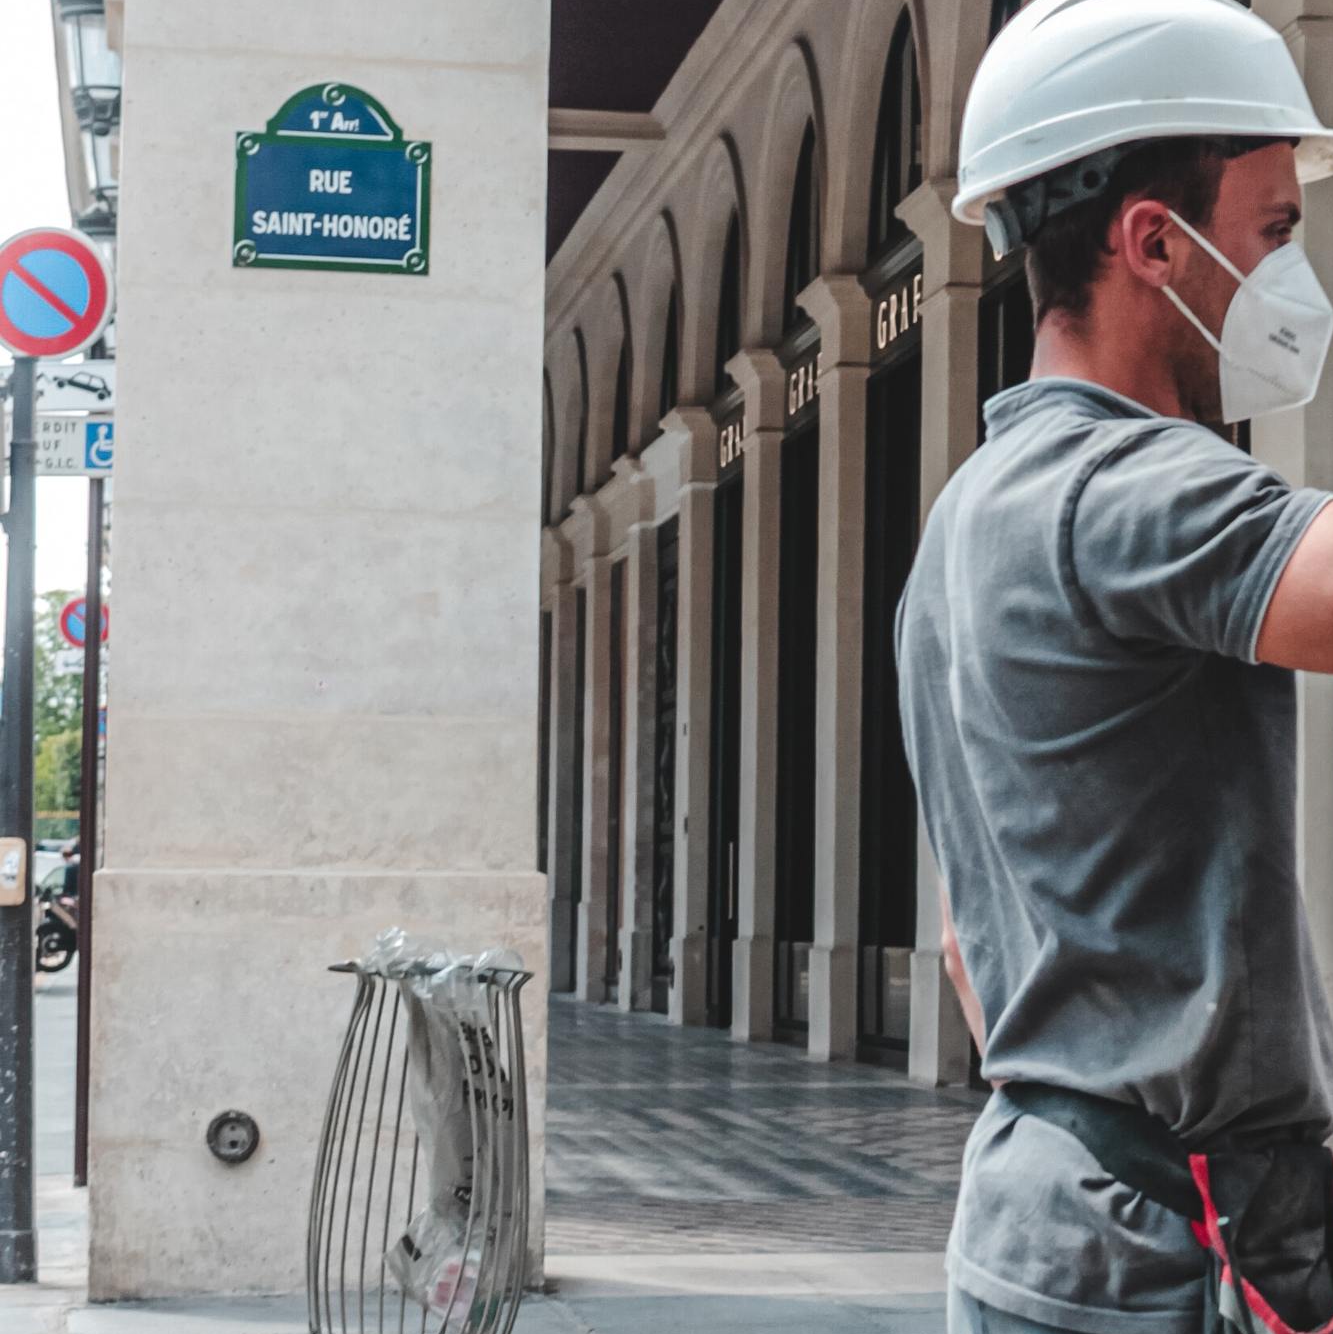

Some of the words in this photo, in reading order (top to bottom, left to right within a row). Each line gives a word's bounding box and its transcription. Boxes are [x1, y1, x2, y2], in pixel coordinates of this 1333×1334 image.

[309, 169, 352, 195] RUE
[252, 210, 412, 241] SAINT-HONORÉ
[877, 273, 922, 350] GRAF
